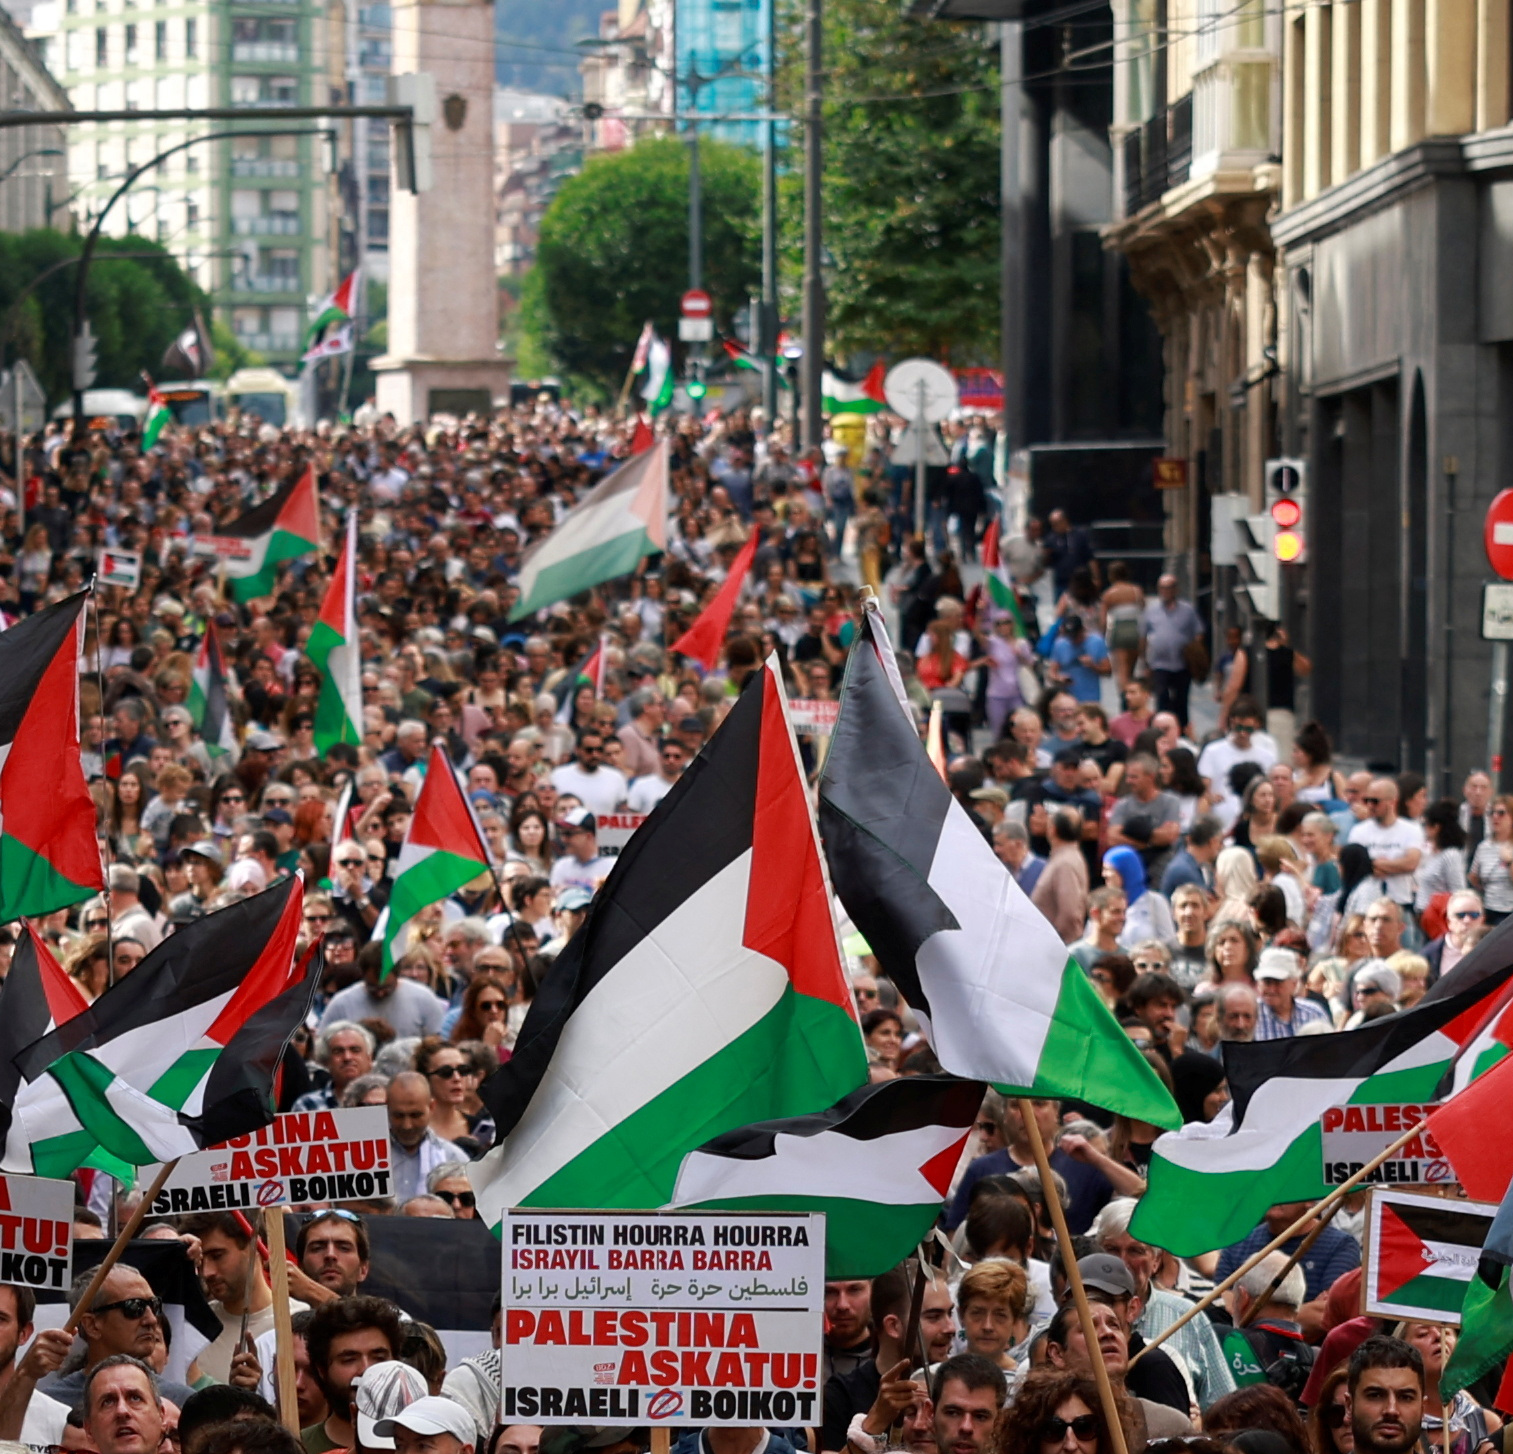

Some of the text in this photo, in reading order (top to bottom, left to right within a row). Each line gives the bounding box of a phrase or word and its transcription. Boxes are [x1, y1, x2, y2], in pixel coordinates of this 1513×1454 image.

[229, 1139, 389, 1181] ASKATU!
[288, 1171, 390, 1203] BOIKOT
[511, 1224, 809, 1247] FILISTIN HOURRA HOURRA
[511, 1249, 773, 1271] ISRAYIL BARRA BARRA
[511, 1276, 809, 1301] فلسطين حرة حرة إسرائيل برا برا
[506, 1309, 760, 1349] PALESTINA
[616, 1350, 818, 1390] ASKATU!
[505, 1386, 817, 1421] ISRAELI BOIKOT
